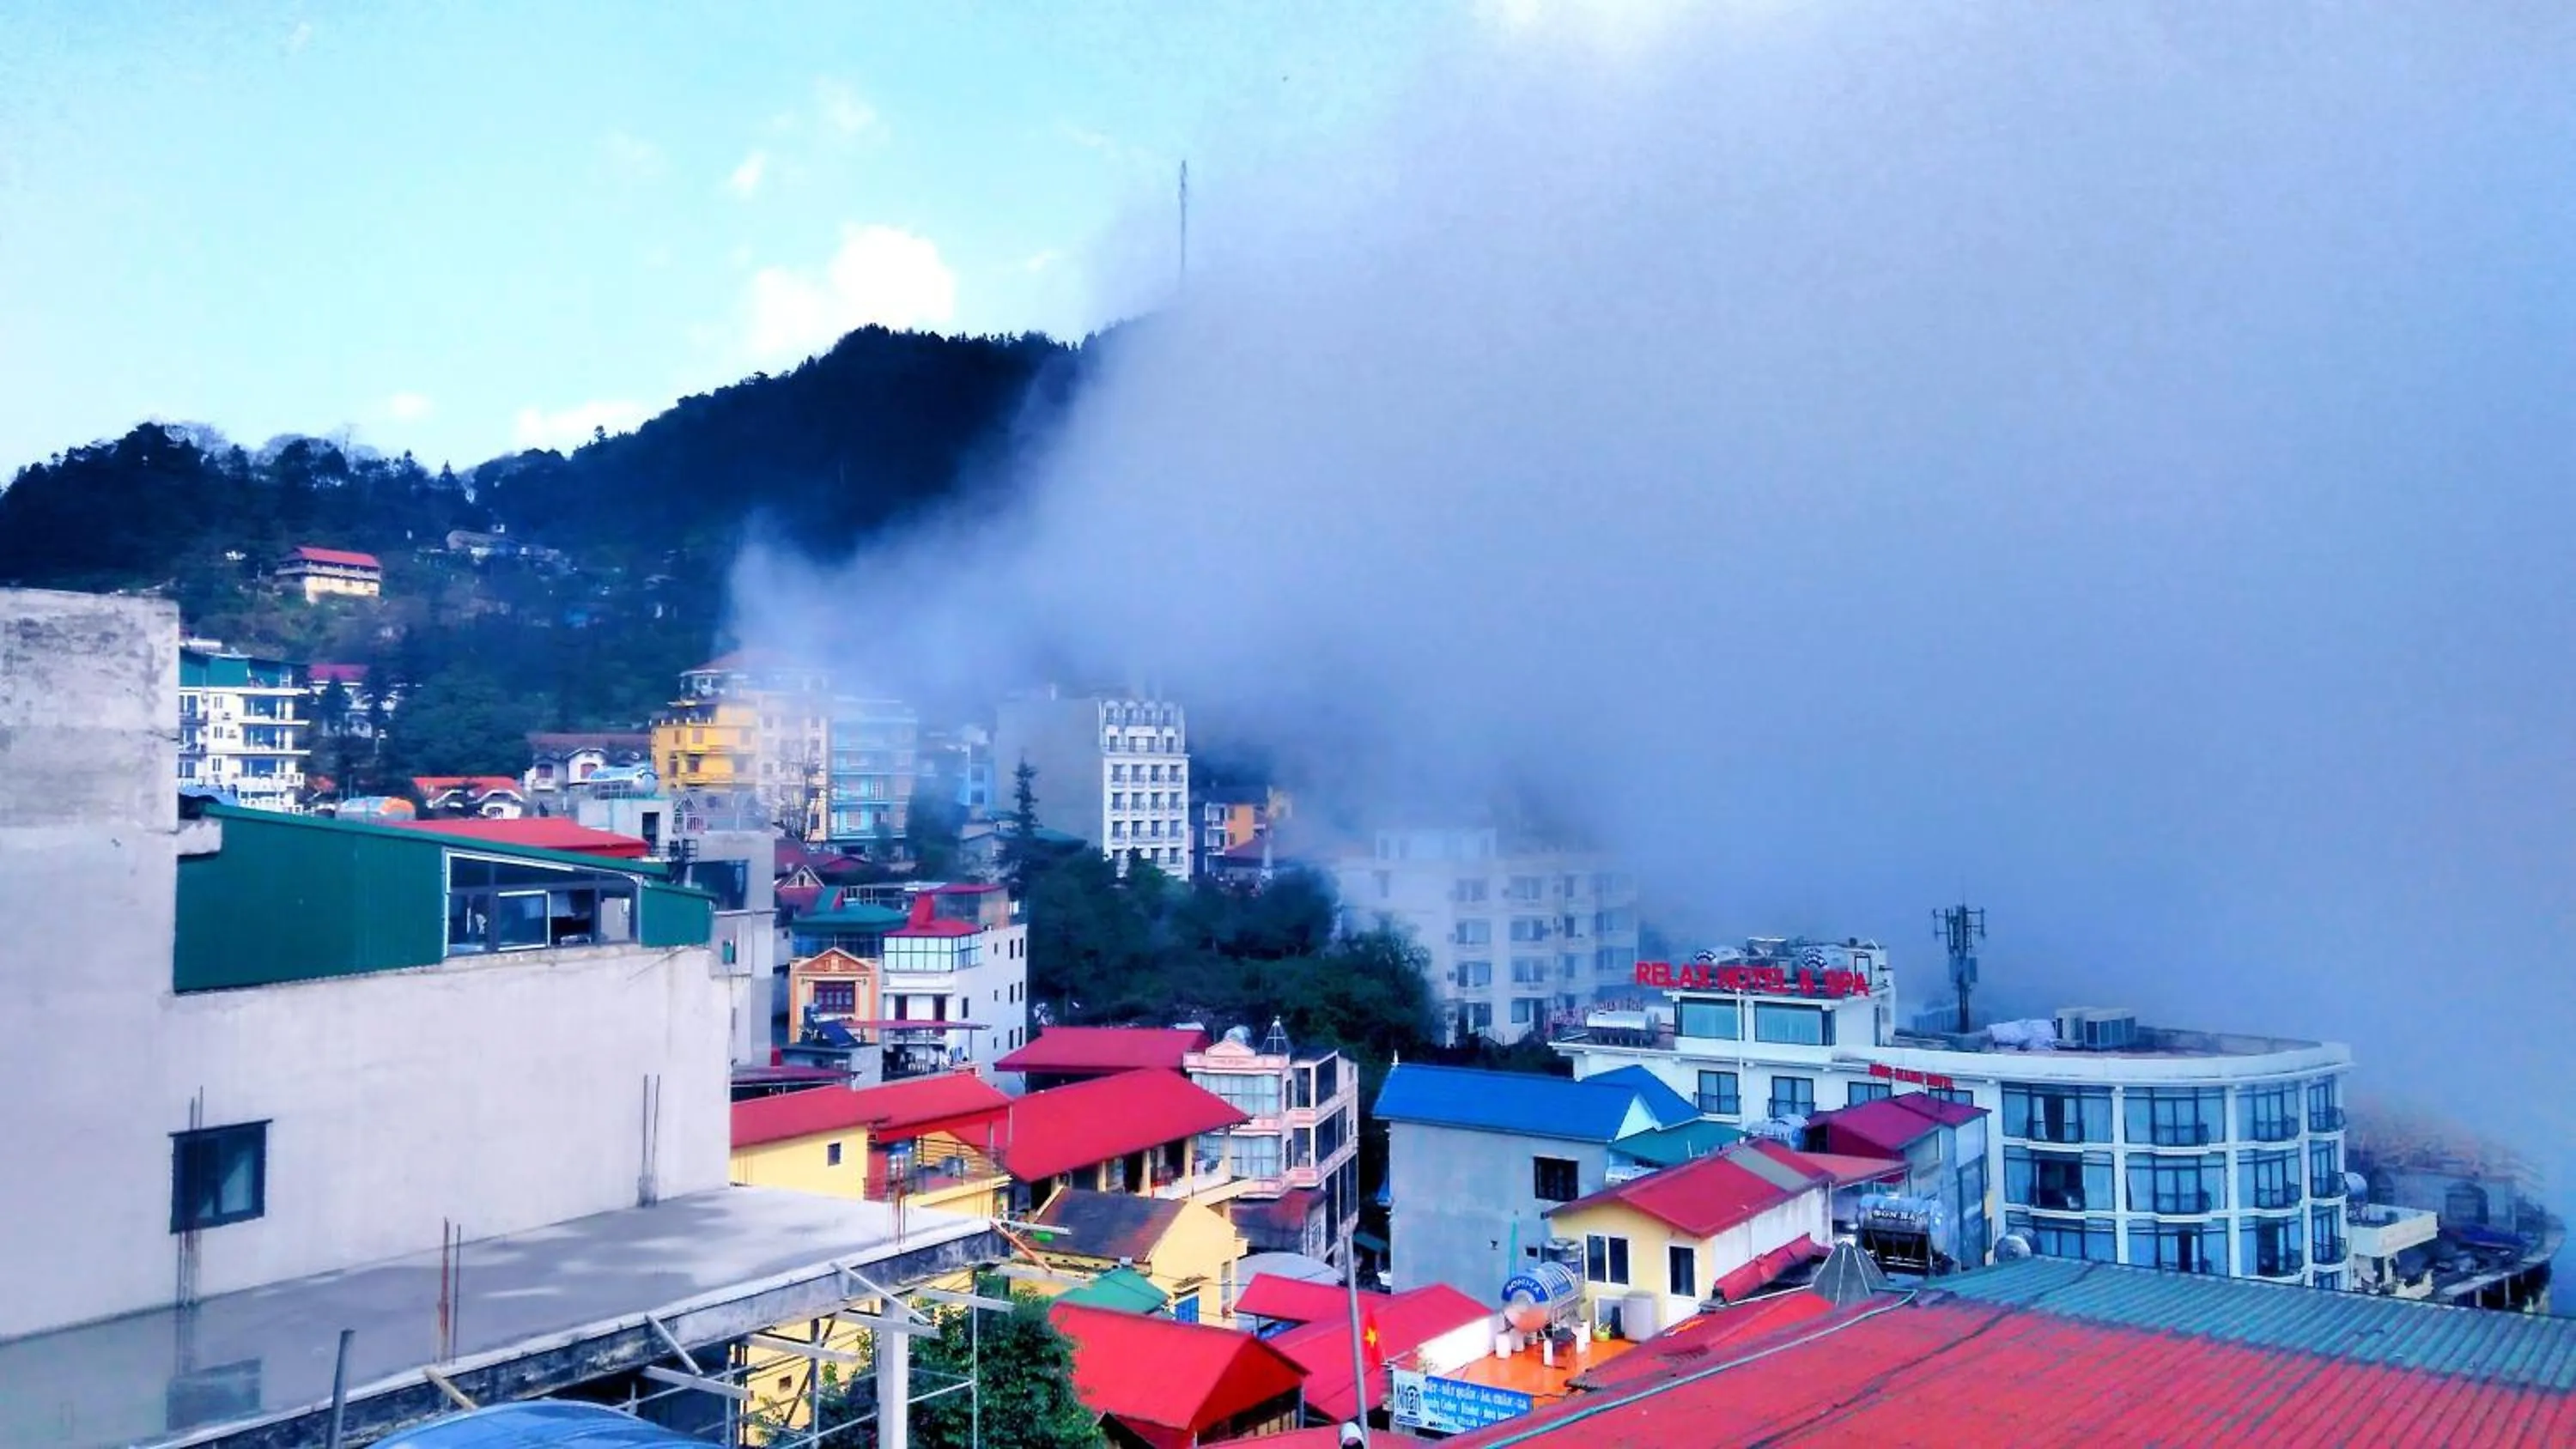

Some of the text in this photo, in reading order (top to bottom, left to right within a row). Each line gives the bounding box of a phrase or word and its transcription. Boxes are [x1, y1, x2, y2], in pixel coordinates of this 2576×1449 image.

[1635, 961, 1711, 988] RELAX
[1716, 965, 1789, 993] HOTEL
[1824, 970, 1869, 997] SPA
